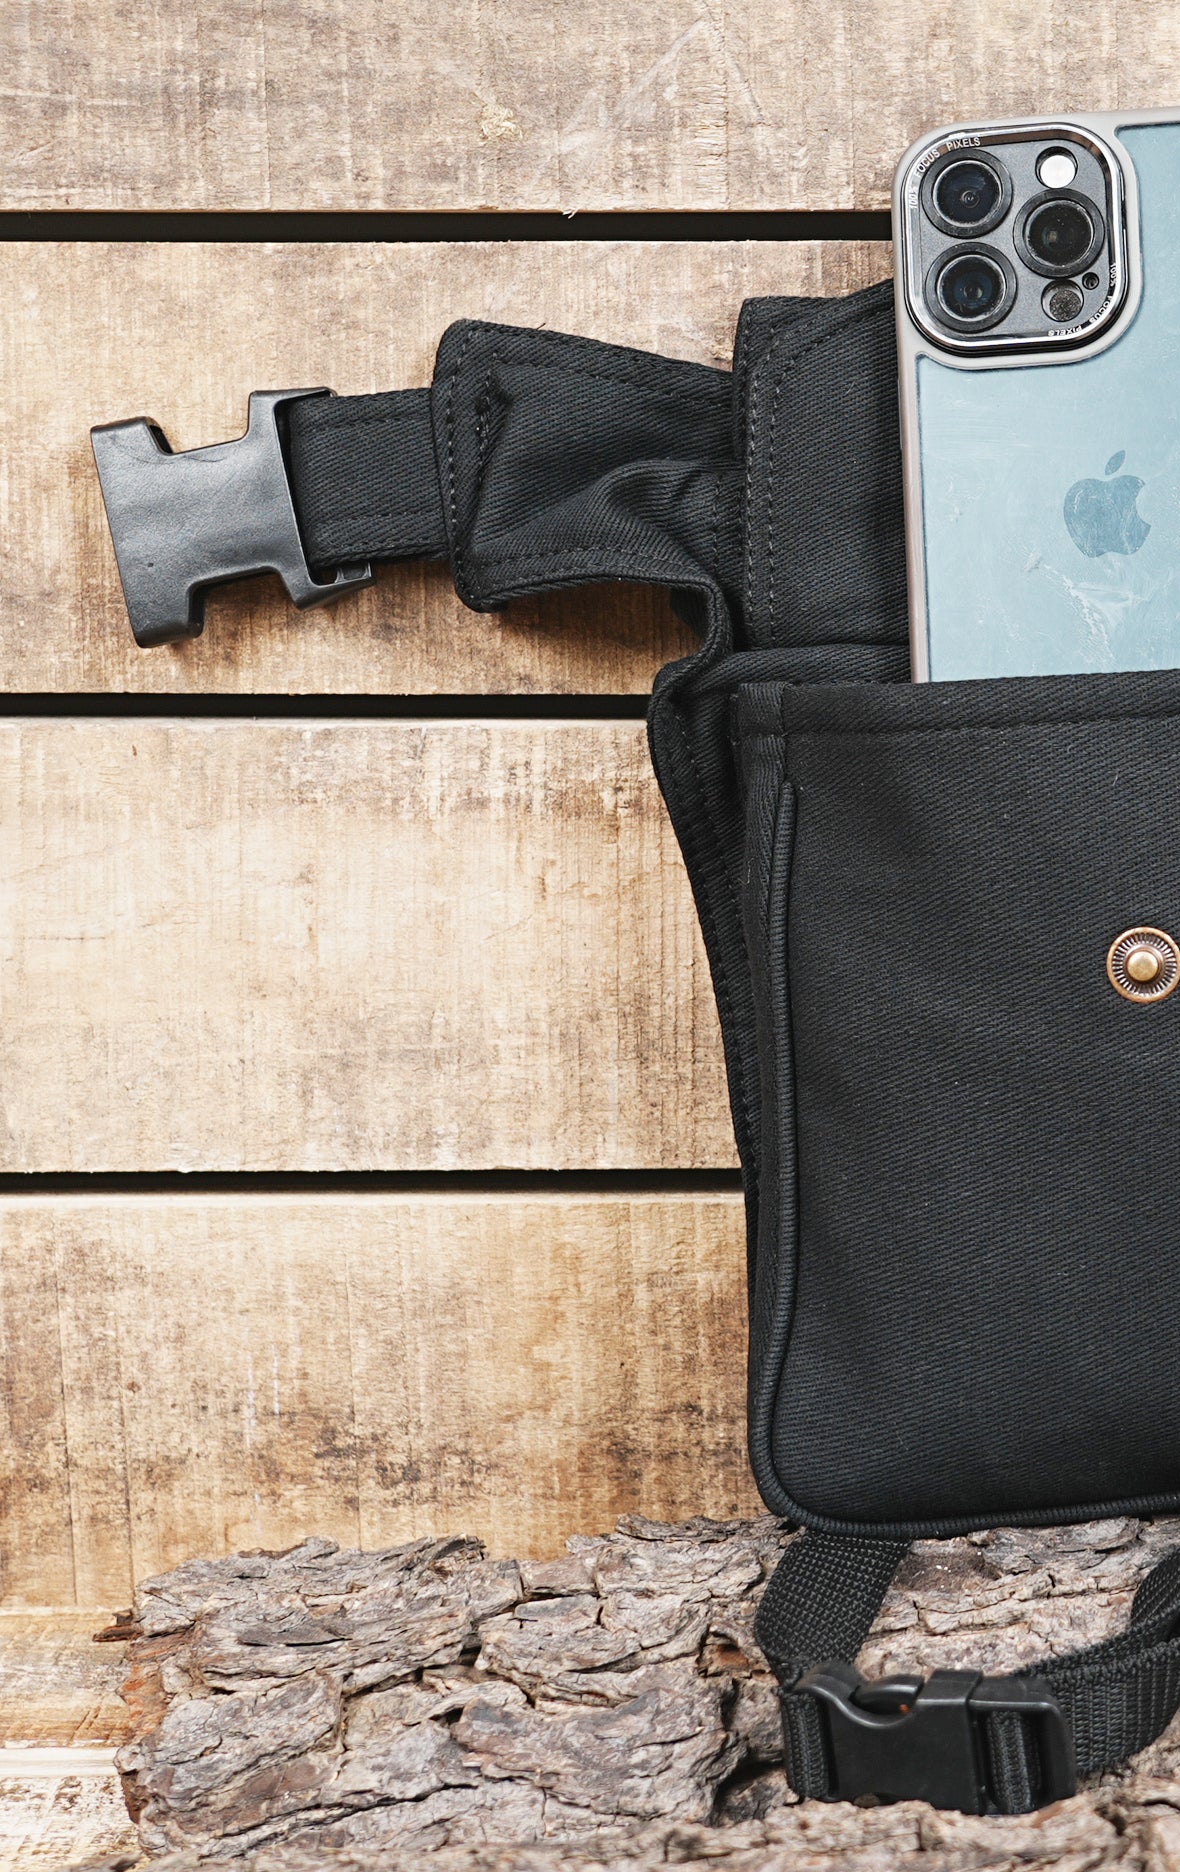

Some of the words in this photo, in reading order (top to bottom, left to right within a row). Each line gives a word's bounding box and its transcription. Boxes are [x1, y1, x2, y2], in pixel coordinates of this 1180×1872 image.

[914, 148, 941, 178] FOCUS
[945, 136, 981, 152] PIXELS
[1047, 325, 1083, 337] PIXELS
